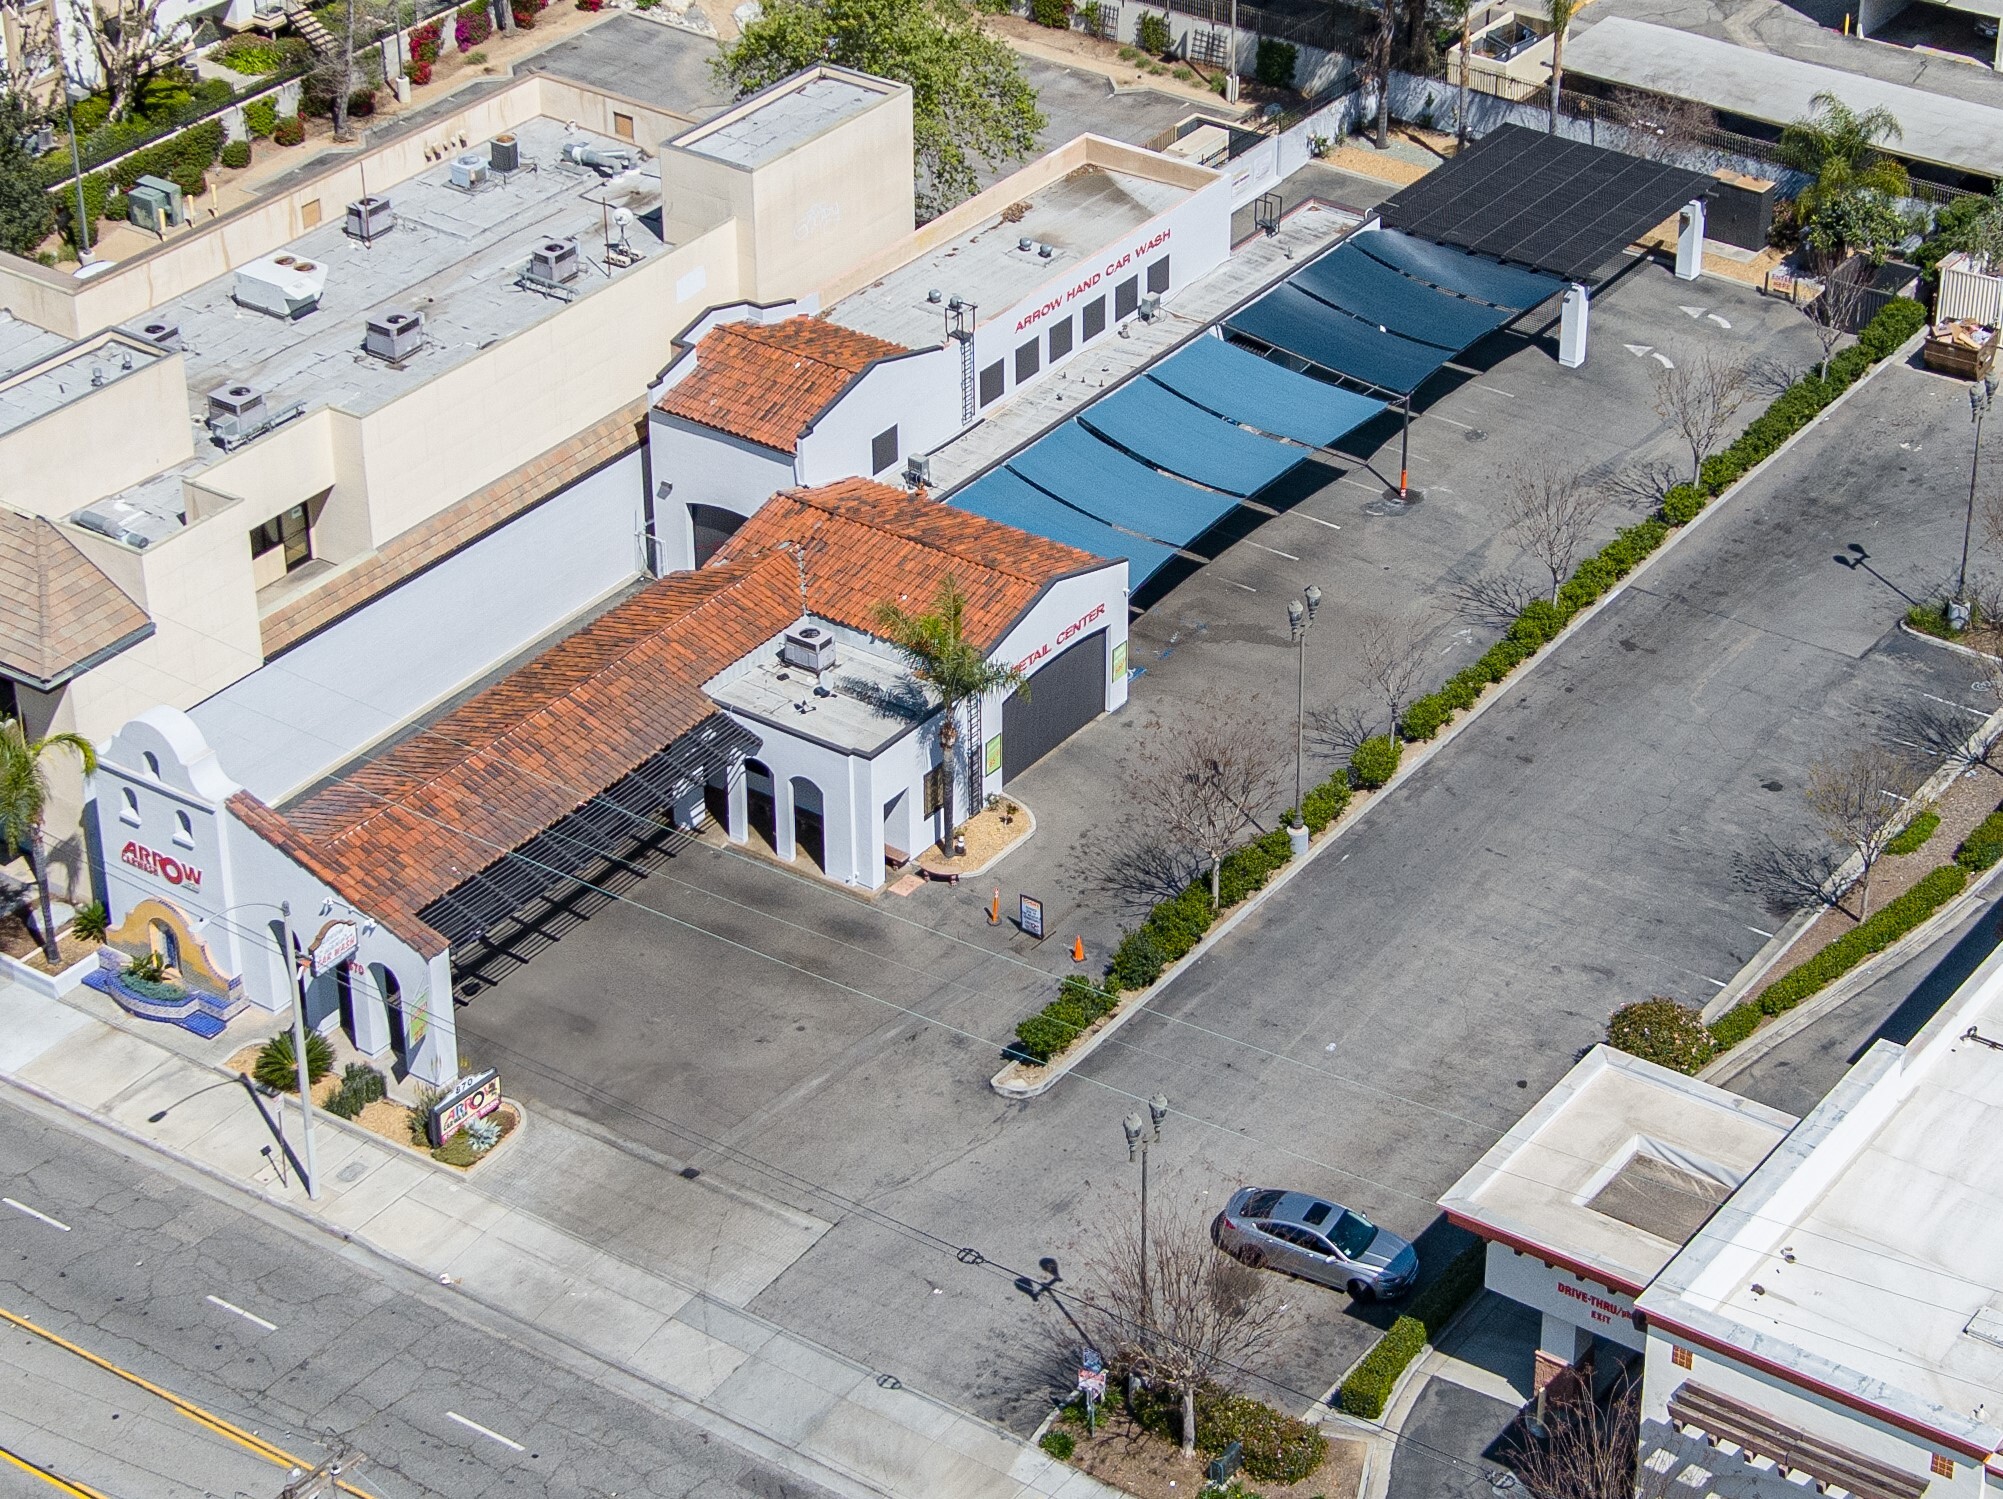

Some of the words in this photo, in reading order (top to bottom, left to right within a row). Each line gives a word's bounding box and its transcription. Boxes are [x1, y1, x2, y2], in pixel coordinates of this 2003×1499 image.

[1015, 295, 1063, 334] ARROW
[1066, 273, 1101, 302] HAND
[1105, 253, 1131, 277] CAR
[1135, 228, 1171, 258] WASH
[1056, 603, 1105, 645] CENTER
[121, 840, 203, 886] ARROW
[455, 1078, 473, 1095] 870
[1591, 1310, 1612, 1325] EXIT
